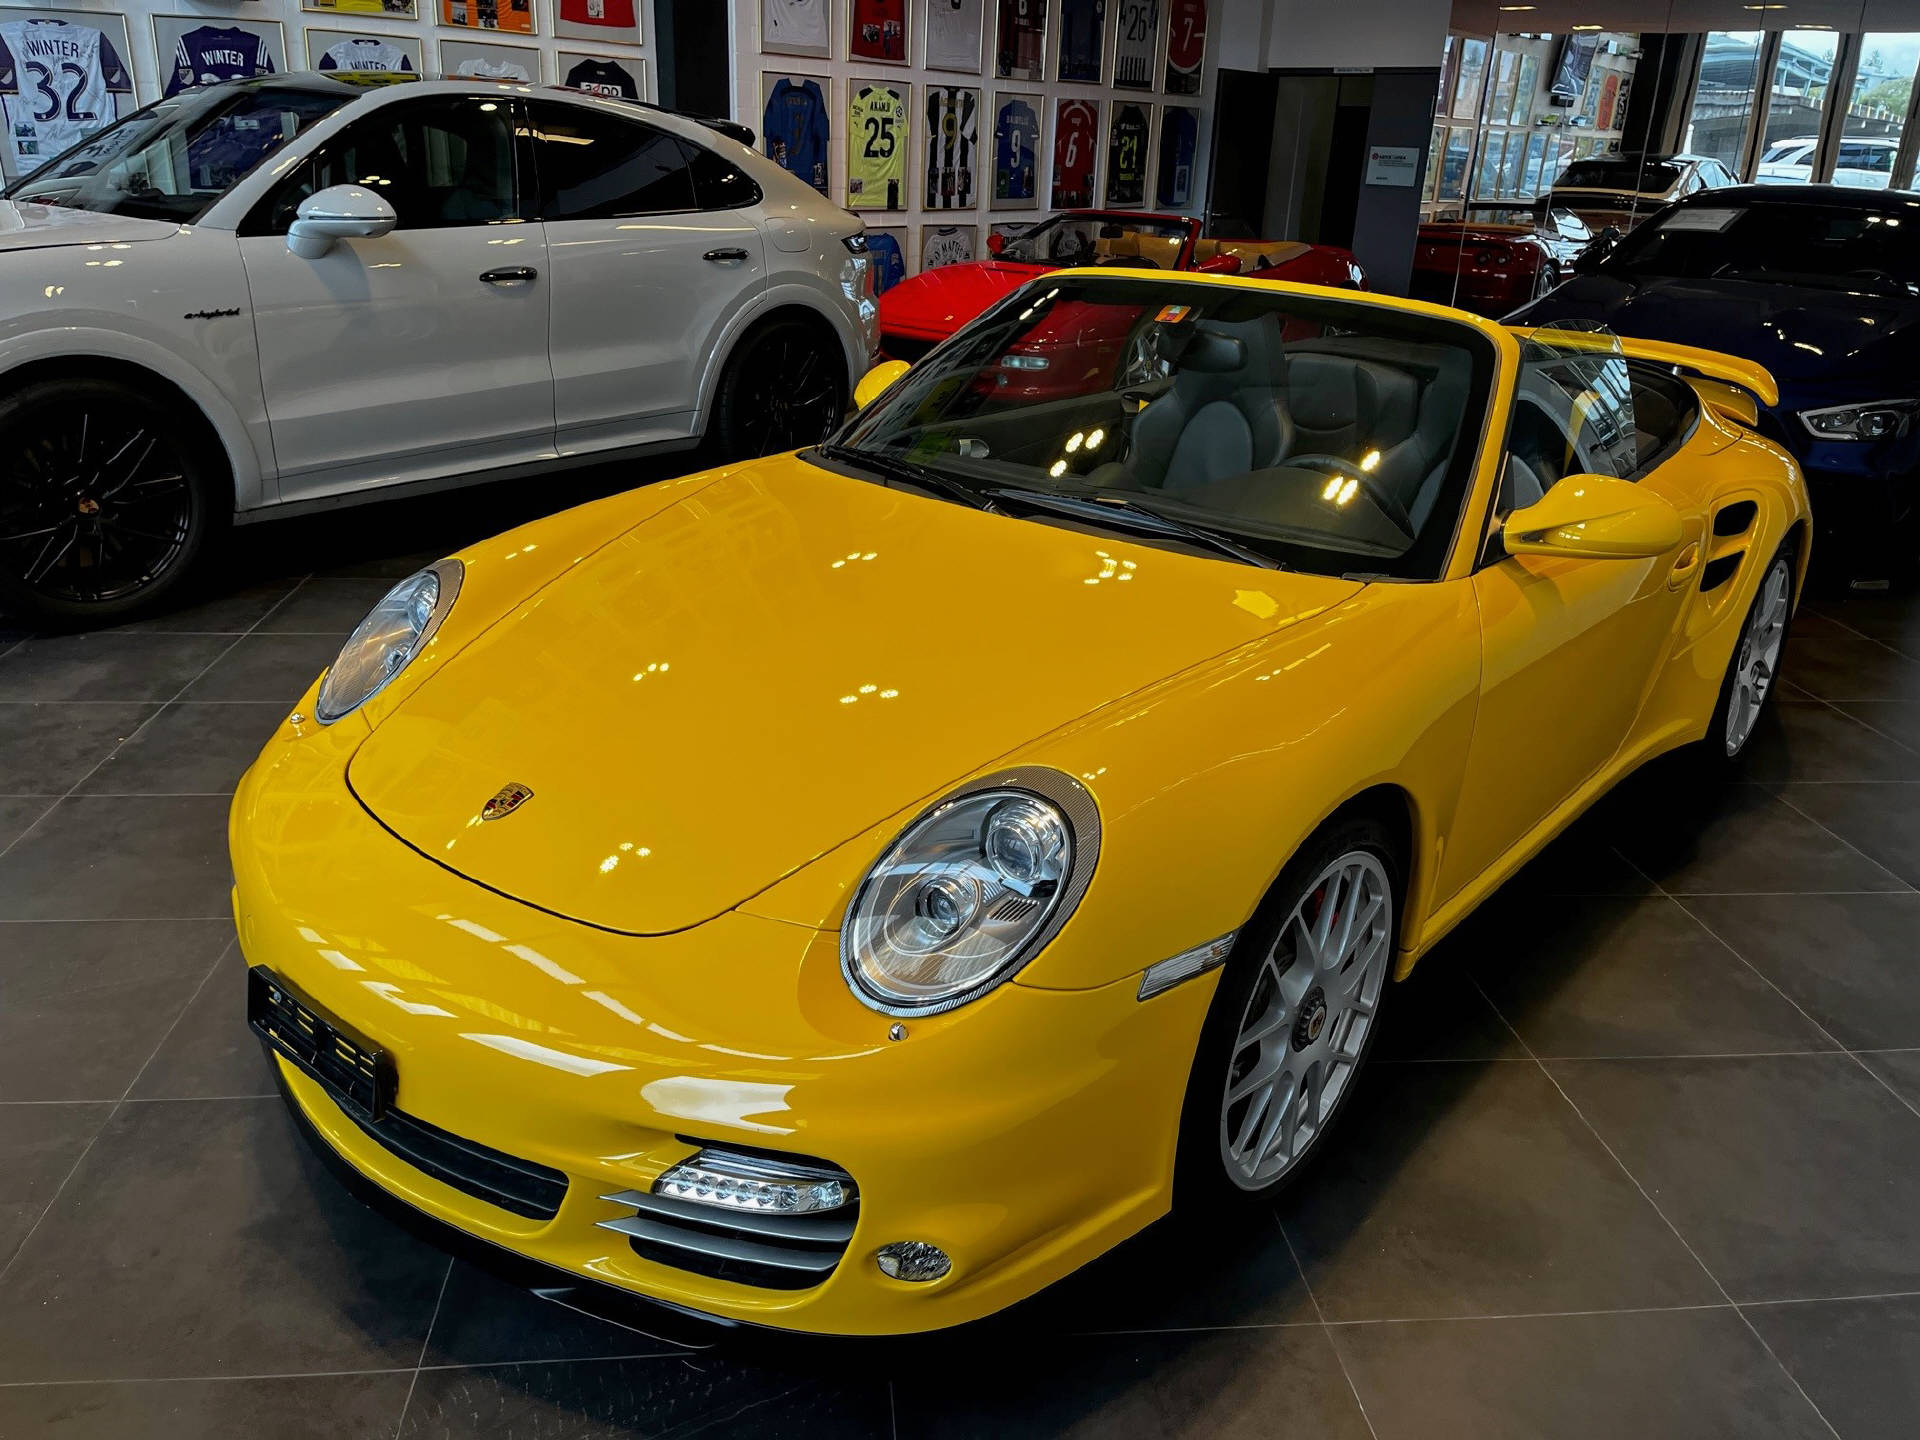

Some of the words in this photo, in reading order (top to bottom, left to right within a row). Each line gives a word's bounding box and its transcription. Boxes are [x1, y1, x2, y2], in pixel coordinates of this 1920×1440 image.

[1127, 5, 1147, 42] 26
[1183, 17, 1195, 52] 7
[26, 39, 79, 58] WINTER
[201, 49, 245, 67] WINTER
[25, 61, 98, 122] 32
[863, 117, 895, 158] 25
[942, 112, 958, 151] 9
[1010, 129, 1021, 168] 9
[1064, 131, 1079, 168] 6
[1119, 135, 1138, 169] 21
